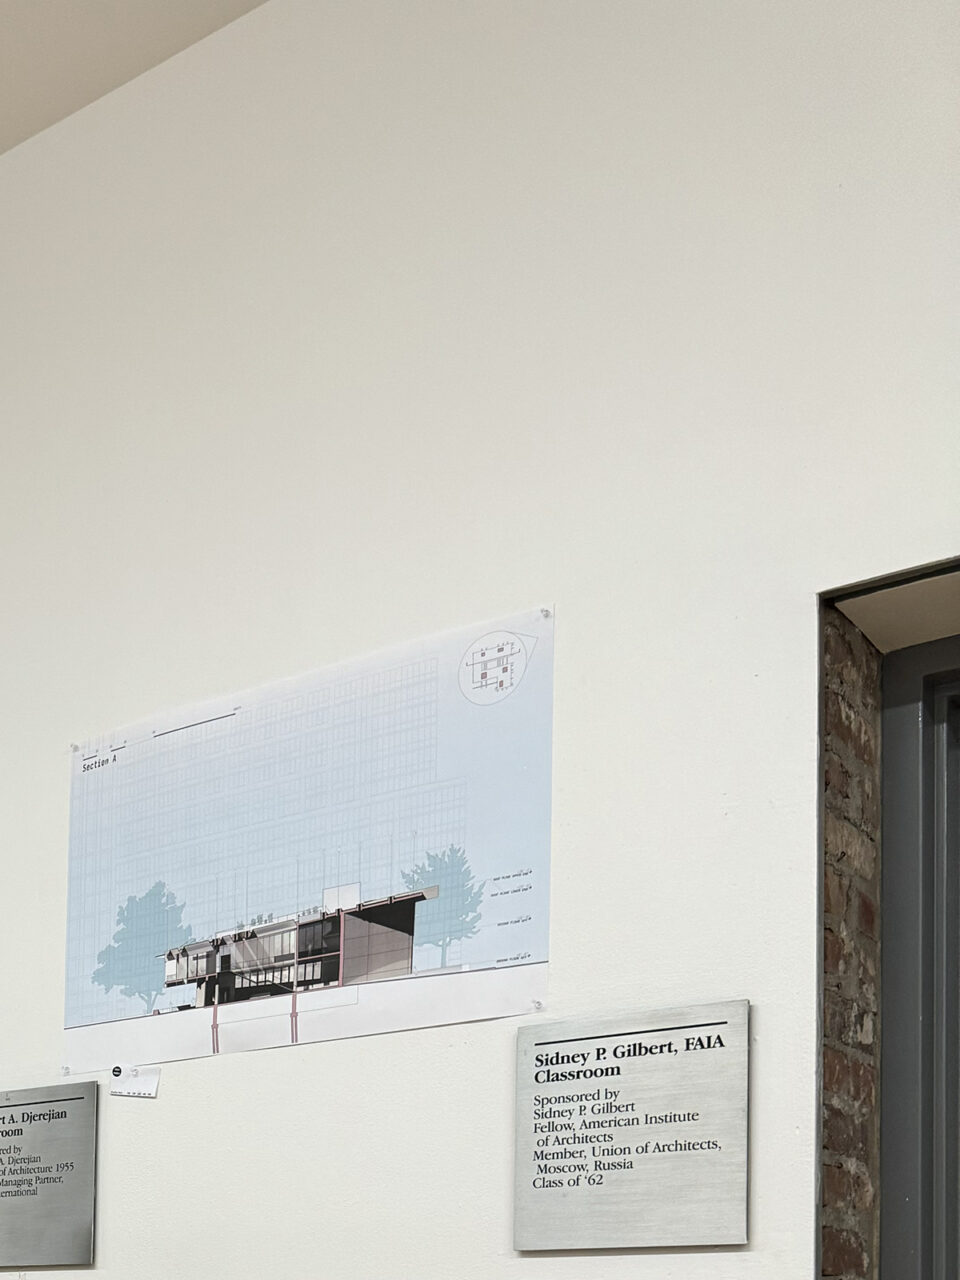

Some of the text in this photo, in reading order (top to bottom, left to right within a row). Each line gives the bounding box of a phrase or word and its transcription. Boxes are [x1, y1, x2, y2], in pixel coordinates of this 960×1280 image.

[82, 758, 109, 772] Section
[534, 1034, 725, 1068] Sidney P. Gilbert, FAIA
[534, 1066, 620, 1084] Classroom
[534, 1088, 620, 1108] Sponsored by
[8, 1114, 18, 1124] A.
[21, 1109, 67, 1124] Djerejian
[534, 1102, 636, 1120] Sidney P. Gilbert
[534, 1111, 700, 1134] Fellow, American Institute
[537, 1132, 614, 1147] of Architects
[14, 1145, 22, 1155] by
[532, 1138, 722, 1161] Member, Union of Architects,
[8, 1156, 41, 1166] Djerejian
[536, 1159, 634, 1175] Moscow, Russia
[8, 1164, 52, 1176] Architecture
[56, 1162, 74, 1172] 1955
[36, 1176, 64, 1184] Partner,
[532, 1177, 564, 1188] Class
[568, 1175, 580, 1187] of
